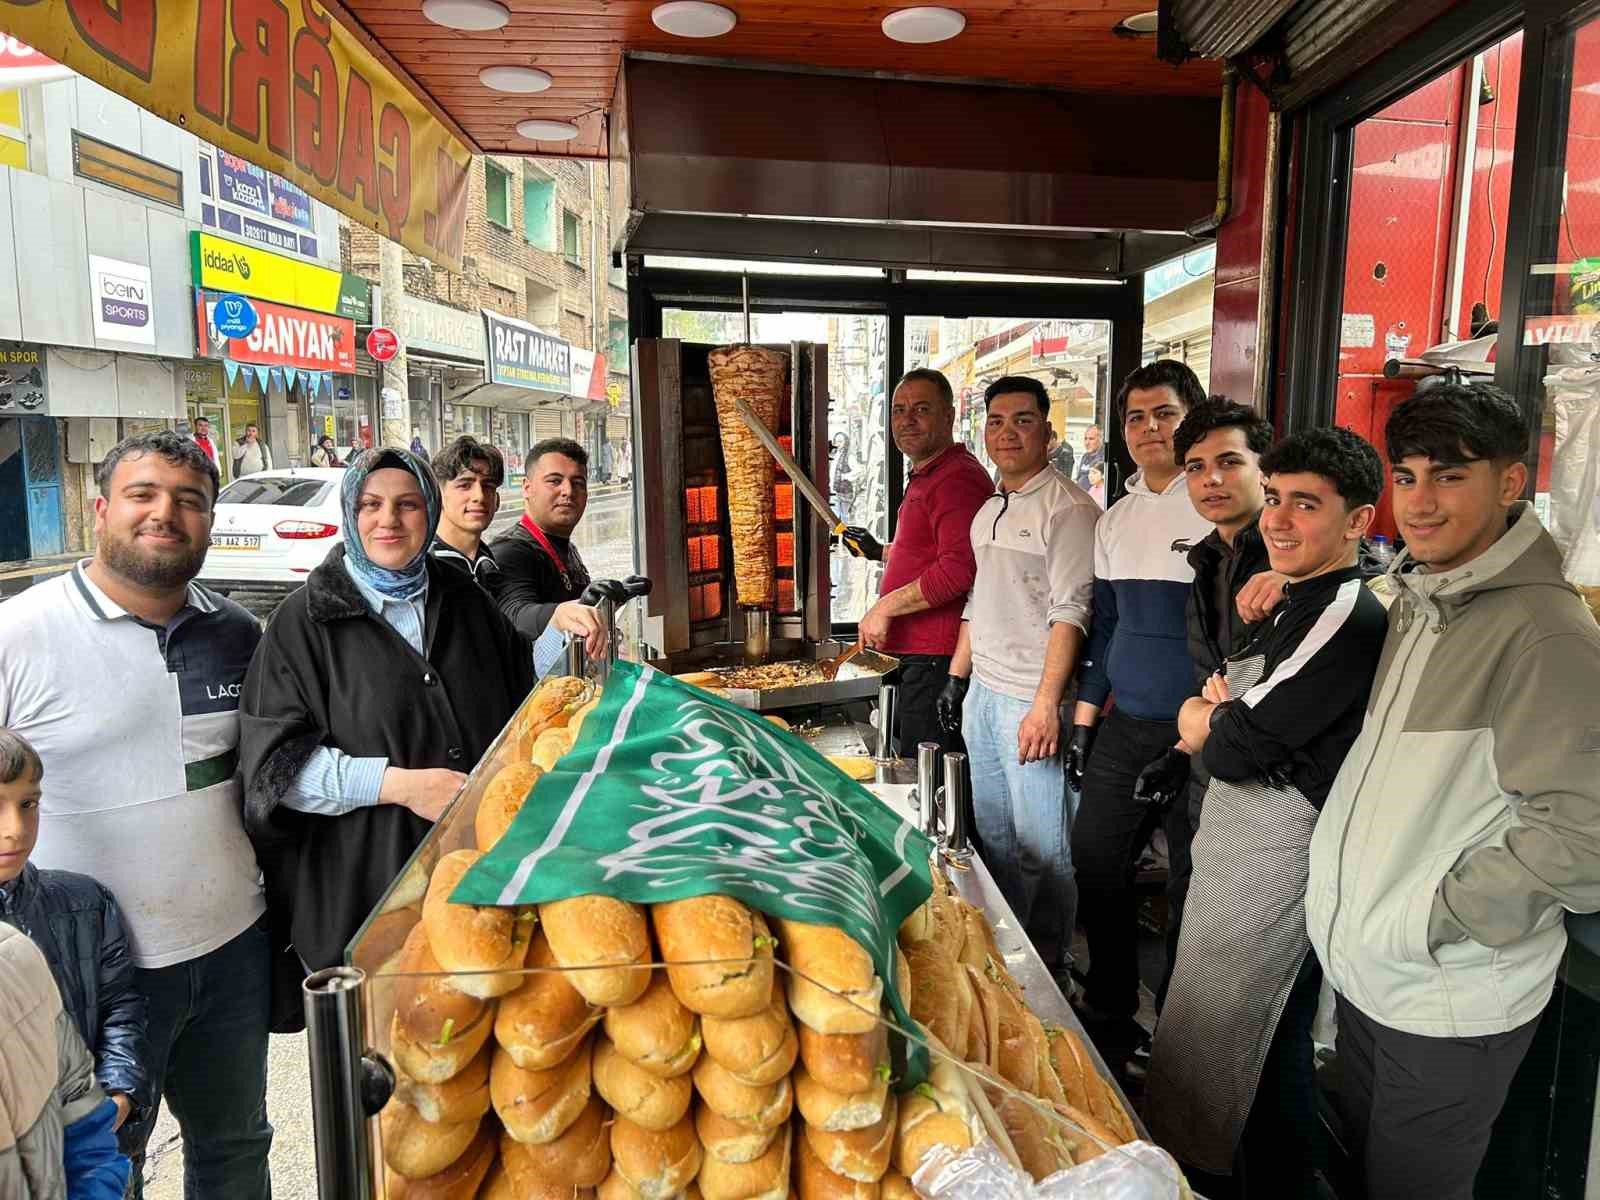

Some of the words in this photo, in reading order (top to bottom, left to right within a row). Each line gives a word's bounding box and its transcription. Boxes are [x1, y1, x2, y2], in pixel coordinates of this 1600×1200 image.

[203, 249, 235, 274] iddaa
[105, 304, 146, 321] SPORTS
[246, 313, 335, 361] GANYAN
[10, 351, 39, 363] SPOR
[495, 326, 526, 364] RAST
[528, 335, 570, 374] MARKET
